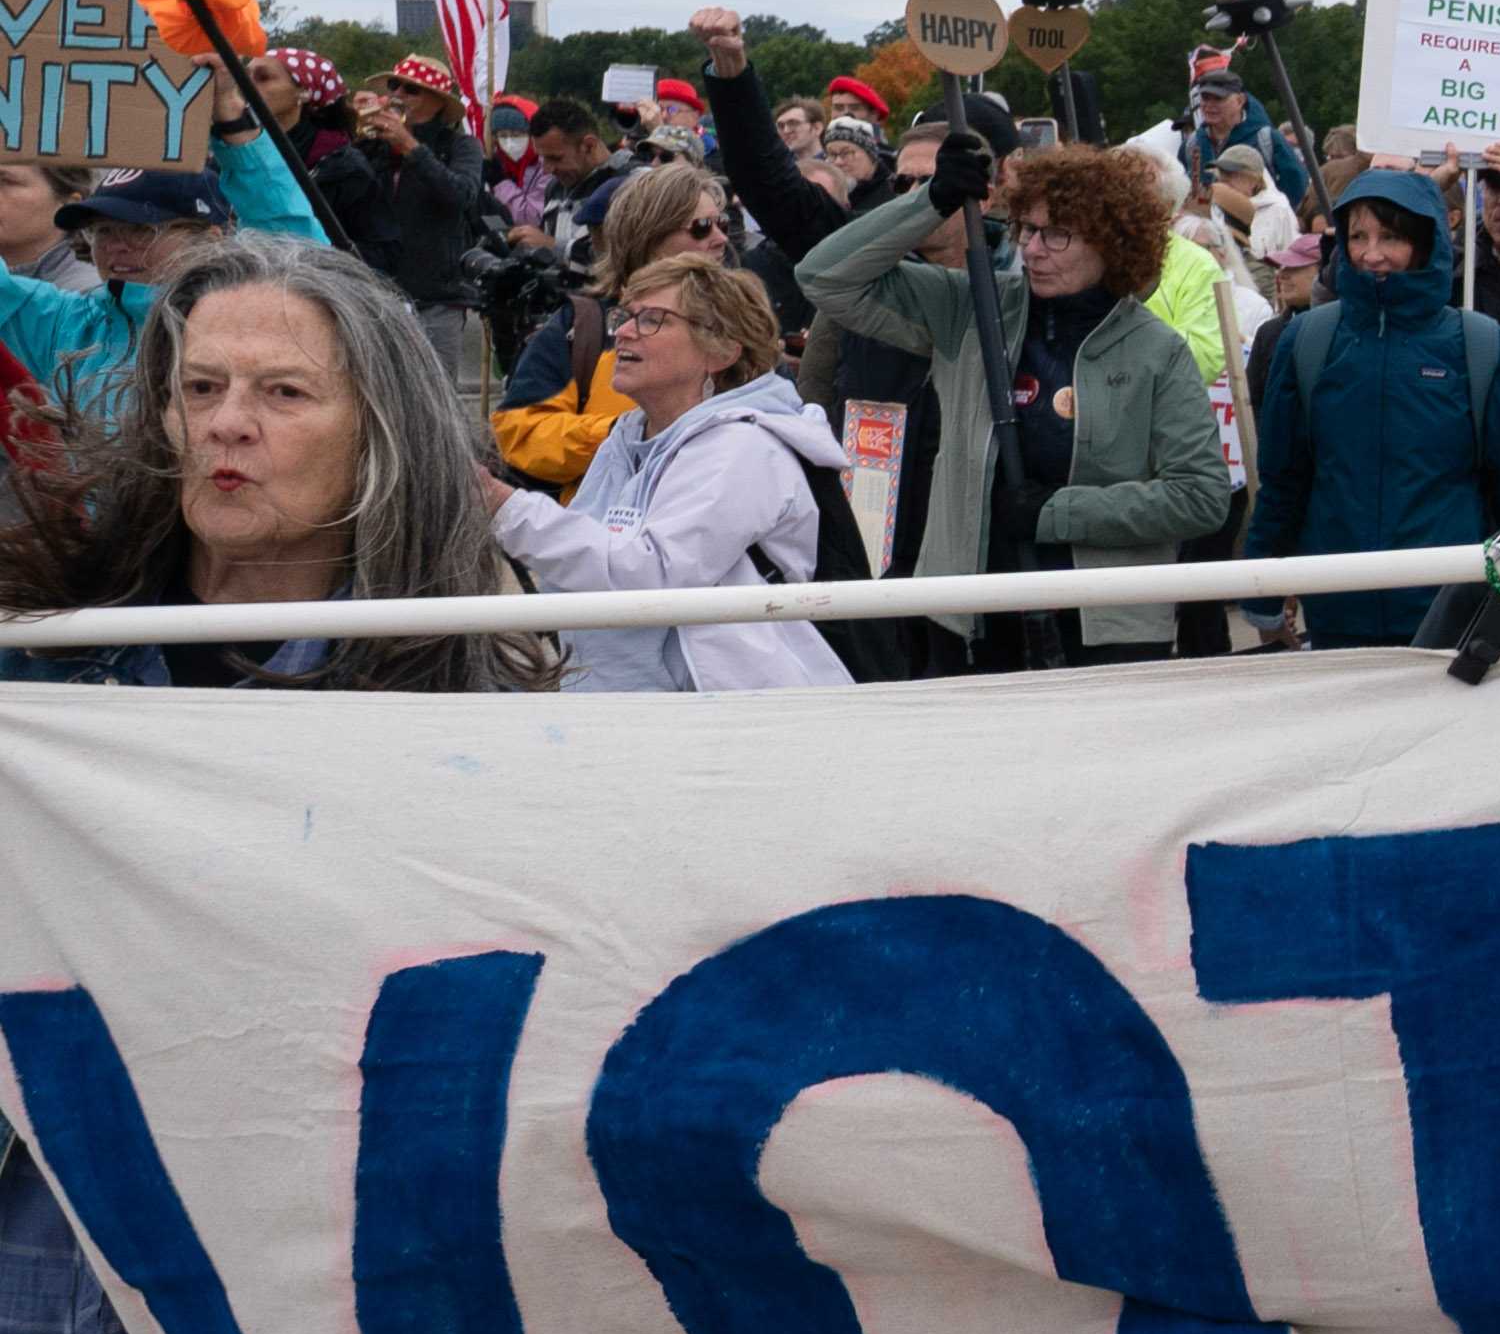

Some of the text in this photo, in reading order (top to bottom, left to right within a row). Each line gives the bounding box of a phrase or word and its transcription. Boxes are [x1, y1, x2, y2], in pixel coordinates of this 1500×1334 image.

[920, 12, 996, 52] HARPY
[1029, 27, 1066, 49] TOOL
[1459, 59, 1471, 71] A
[1441, 79, 1485, 100] BIG
[1423, 106, 1496, 131] ARCH
